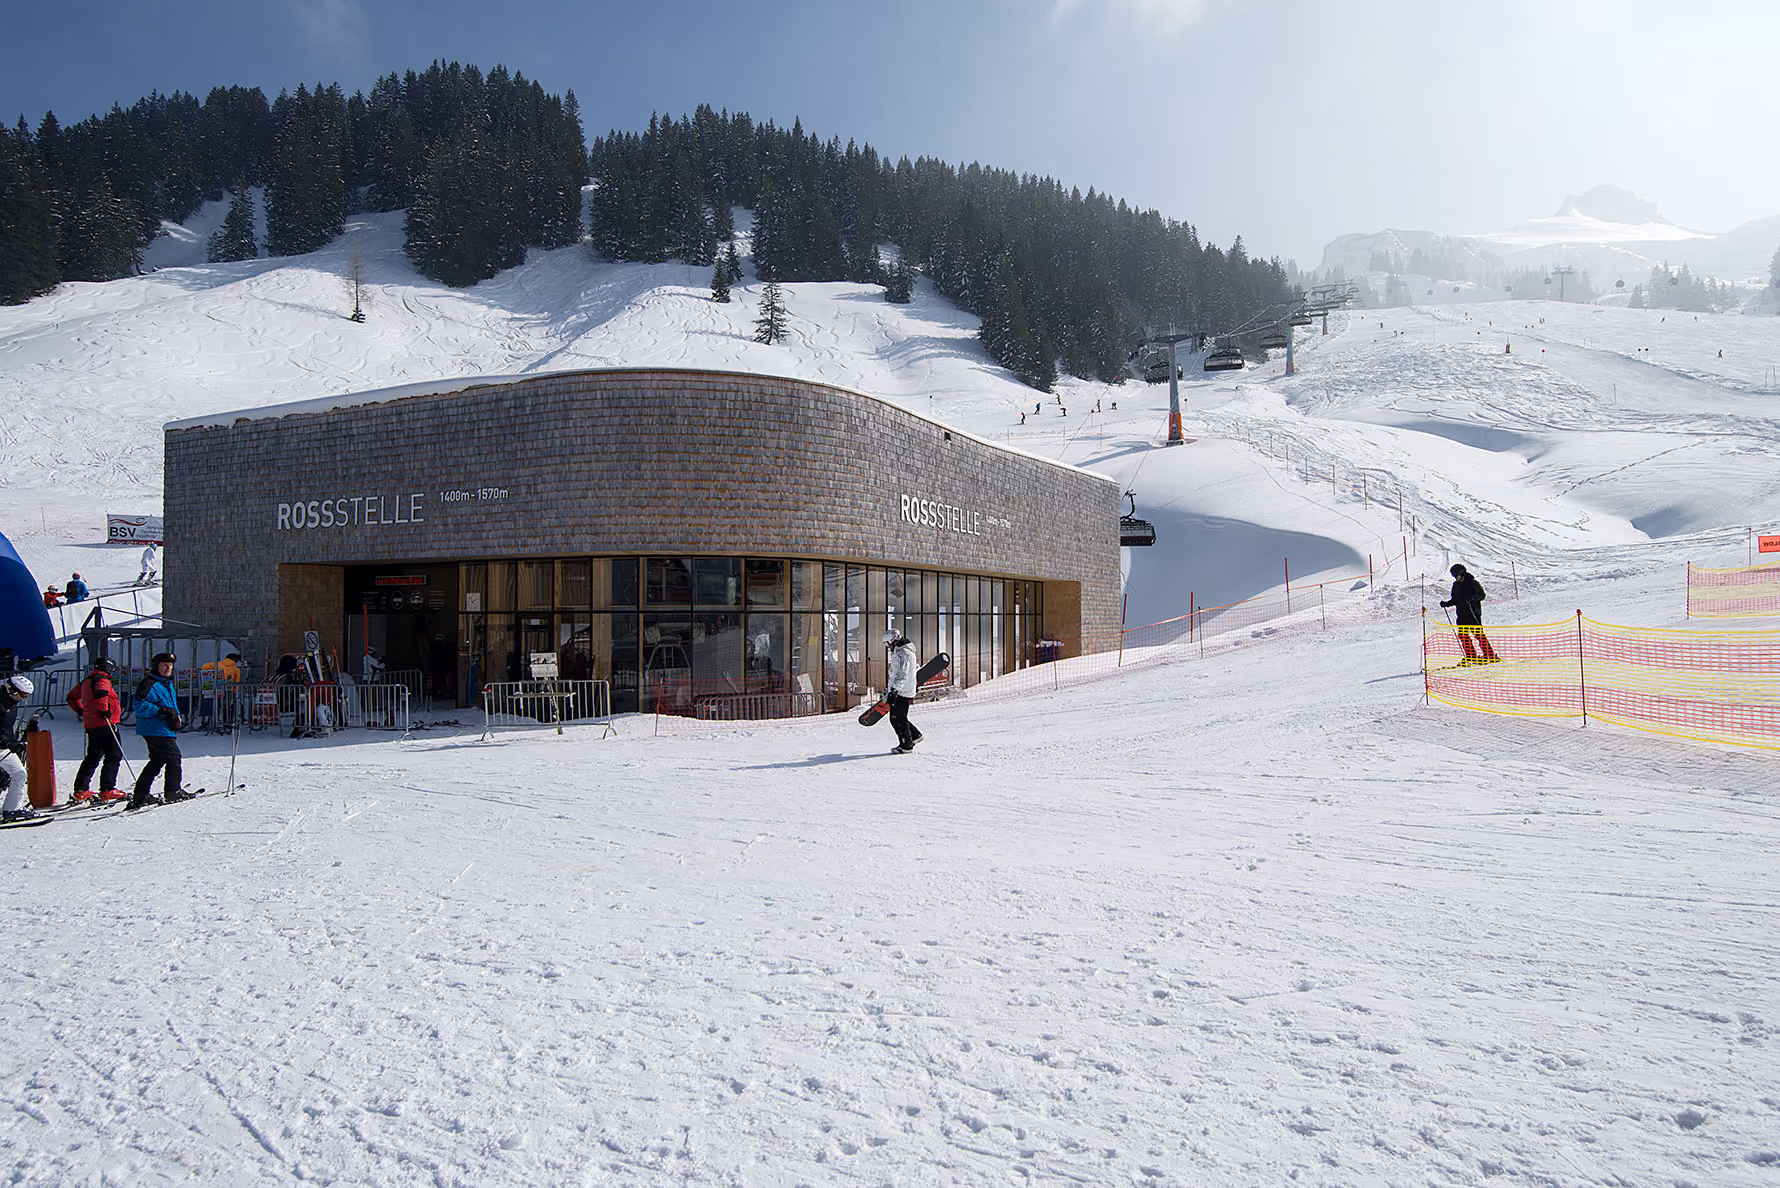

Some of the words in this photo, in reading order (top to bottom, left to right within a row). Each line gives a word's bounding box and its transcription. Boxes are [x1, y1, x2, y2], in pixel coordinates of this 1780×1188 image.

[277, 493, 425, 530] ROSSSTELLE
[900, 494, 980, 536] ROSSSTELLE
[110, 527, 136, 537] BSV
